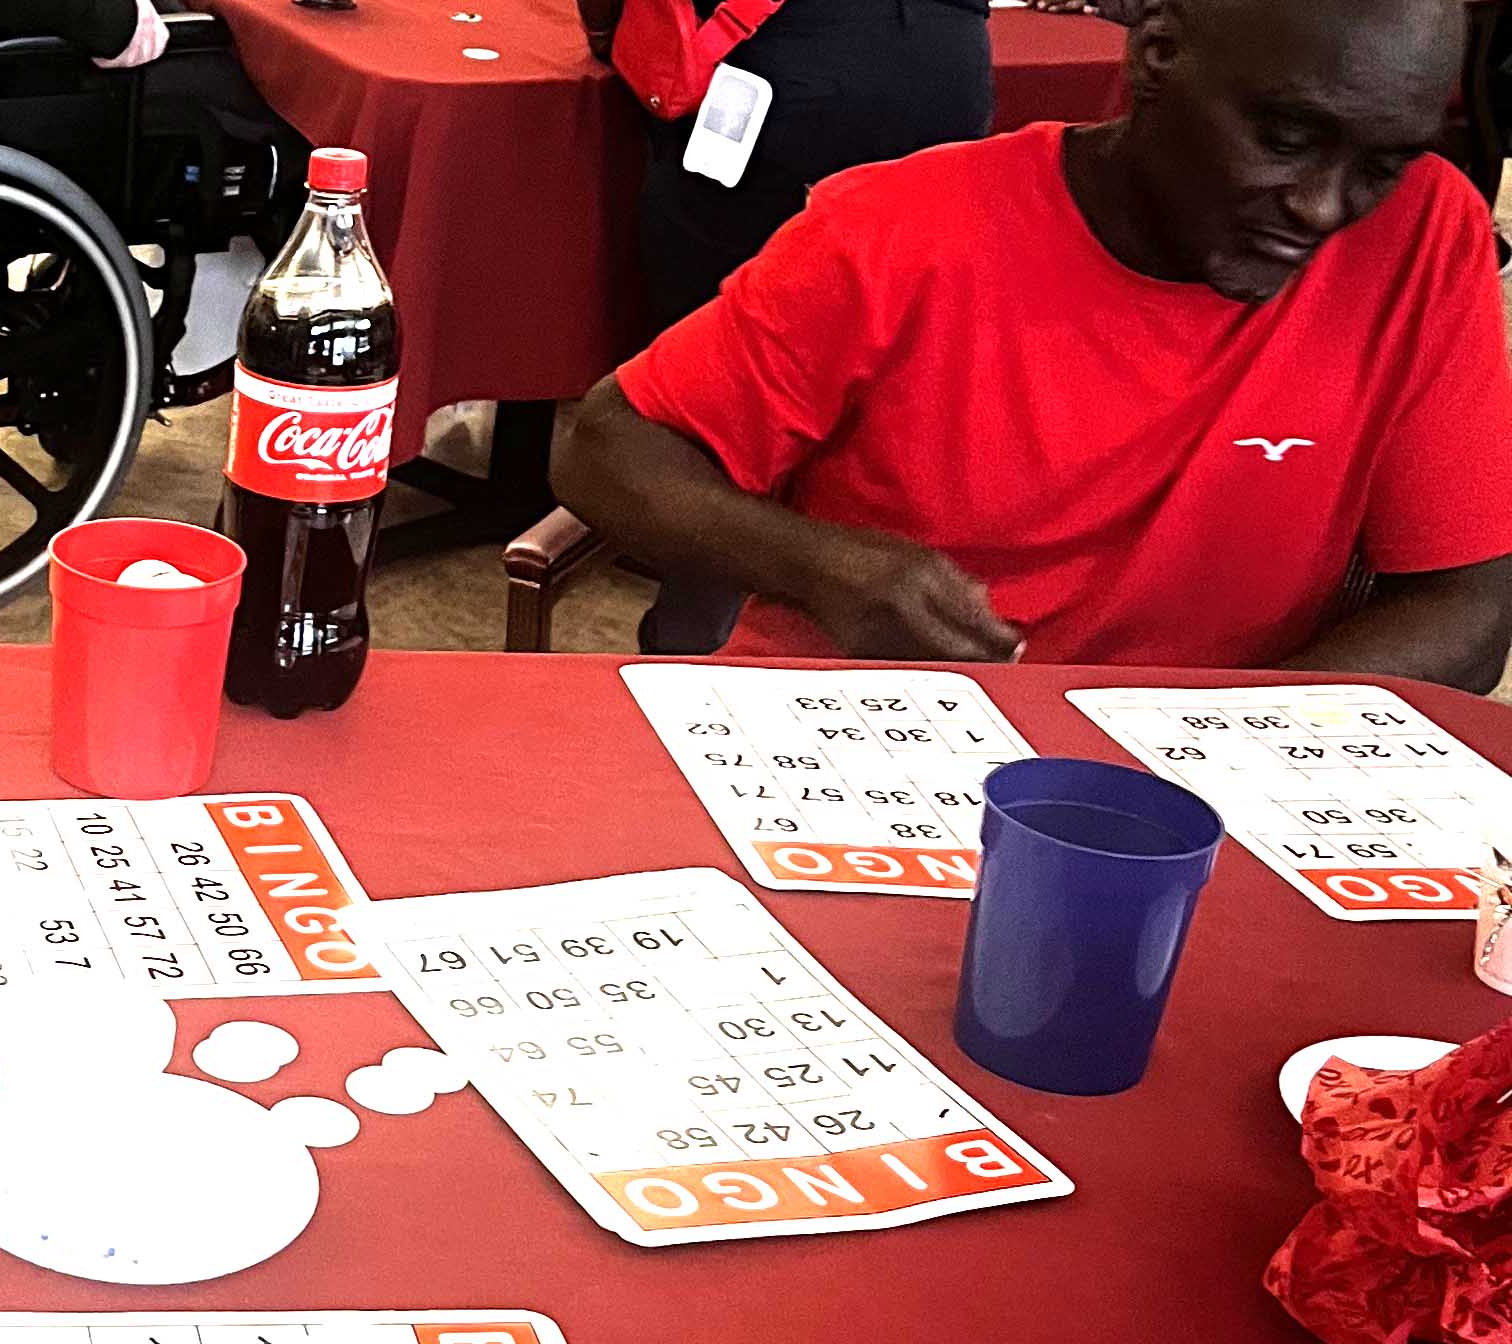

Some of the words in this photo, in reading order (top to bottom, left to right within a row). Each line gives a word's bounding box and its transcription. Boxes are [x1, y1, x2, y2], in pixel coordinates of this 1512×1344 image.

[258, 407, 392, 471] Coca-Col
[794, 697, 842, 711] 33
[859, 698, 909, 712] 25
[936, 699, 959, 712] 4
[687, 722, 731, 736] 62
[1181, 716, 1230, 730] 58
[1242, 715, 1290, 730] 39
[1360, 712, 1407, 726] 13
[816, 727, 866, 741] 34
[884, 728, 933, 743] 30
[965, 729, 985, 744] 1
[703, 753, 753, 768] 75
[1155, 746, 1207, 761] 62
[1278, 745, 1325, 760] 42
[1341, 744, 1392, 759] 25
[1403, 742, 1449, 757] 11
[772, 755, 821, 770] 58
[729, 784, 777, 799] 71
[800, 787, 845, 802] 57
[864, 789, 916, 805] 35
[75, 812, 114, 835] 10
[753, 817, 799, 833] 67
[1301, 809, 1353, 825] 50
[1364, 808, 1417, 824] 36
[889, 823, 943, 840] 38
[89, 845, 131, 869] 25
[170, 841, 211, 866] 26
[1281, 843, 1336, 859] 71
[1346, 843, 1399, 859] 59
[774, 847, 976, 882] NGO
[10, 848, 48, 873] 22
[39, 919, 80, 944] 53
[108, 879, 148, 902] 41
[191, 876, 230, 902] 42
[222, 804, 371, 971] BINGO
[123, 916, 167, 940] 57
[207, 912, 250, 937] 50
[560, 936, 615, 958] 39
[631, 928, 684, 950] 19
[227, 948, 271, 976] 66
[419, 950, 467, 973] 67
[489, 943, 541, 965] 51
[141, 952, 185, 980] 72
[760, 966, 787, 986] 1
[525, 988, 582, 1010] 50
[599, 980, 656, 1003] 35
[449, 996, 505, 1018] 66
[718, 1017, 776, 1040] 30
[790, 1009, 847, 1032] 13
[489, 1039, 548, 1063] 64
[566, 1034, 624, 1054] 55
[763, 1063, 824, 1088] 25
[841, 1053, 897, 1077] 11
[687, 1074, 741, 1096] 45
[531, 1086, 594, 1108] 74
[731, 1121, 791, 1144] 42
[812, 1109, 876, 1136] 26
[656, 1127, 718, 1150] 58
[622, 1140, 1025, 1218] BINGO
